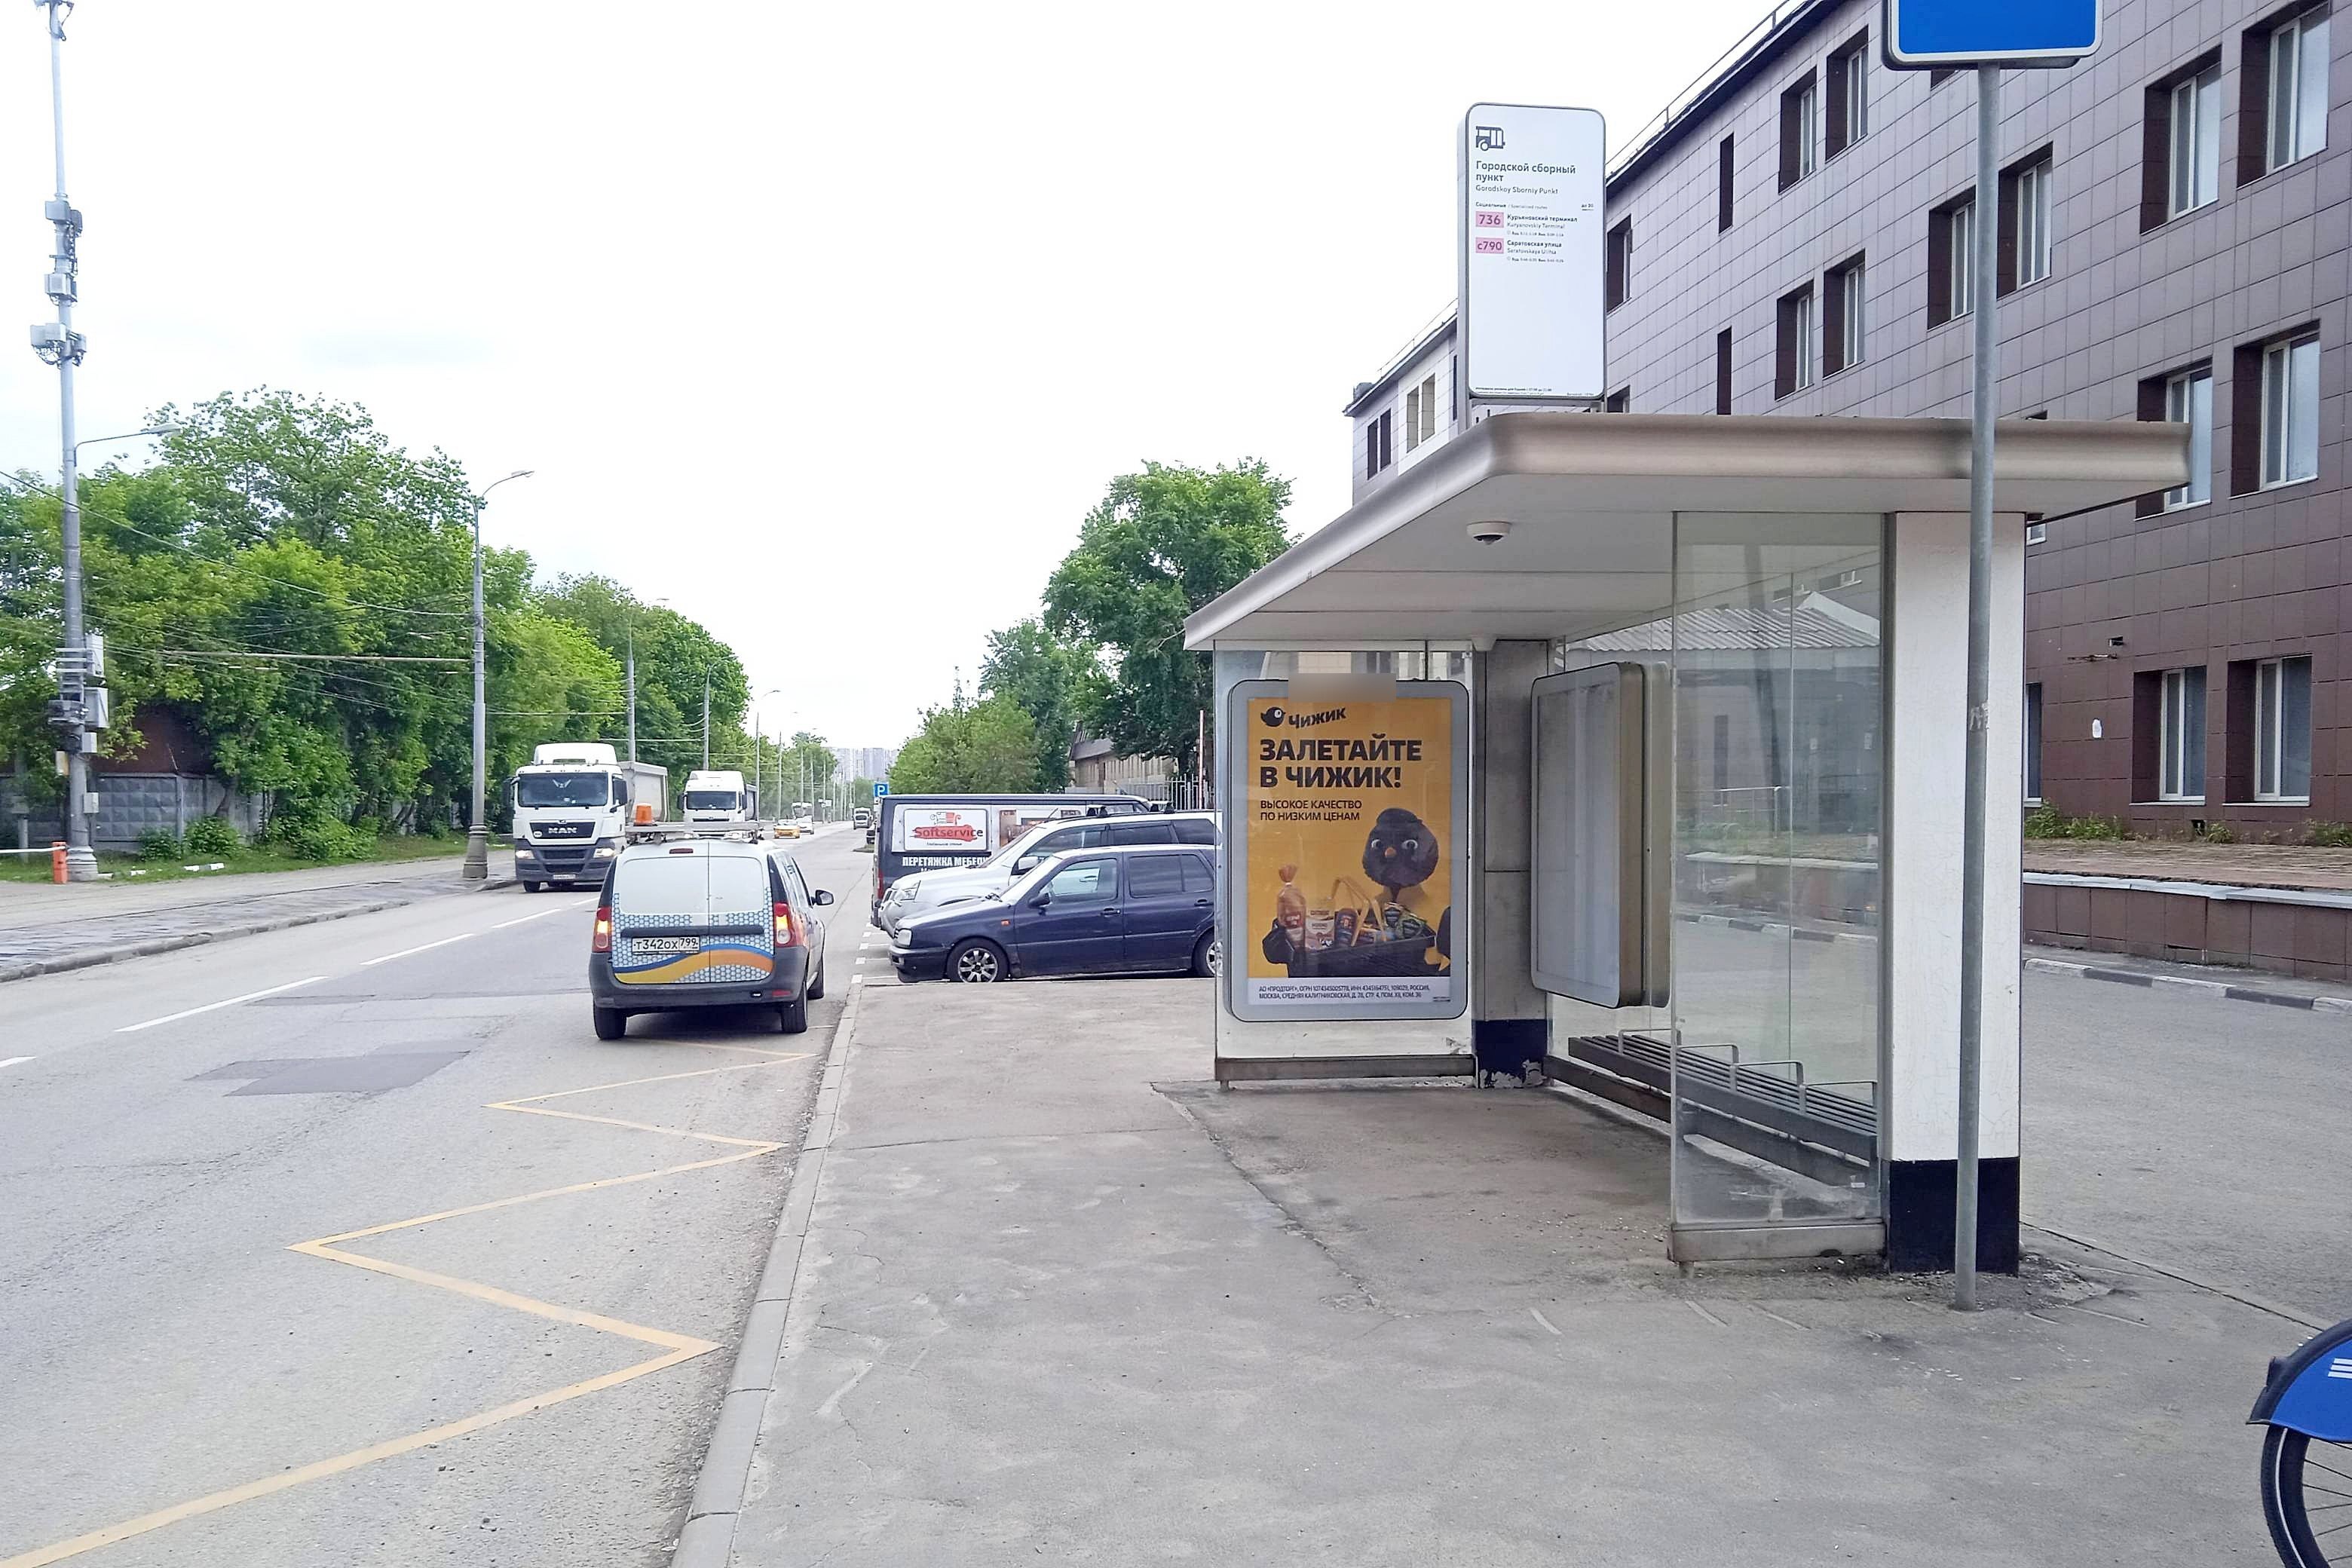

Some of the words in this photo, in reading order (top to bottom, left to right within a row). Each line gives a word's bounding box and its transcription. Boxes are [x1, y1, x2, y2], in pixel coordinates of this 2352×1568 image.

[1476, 161, 1530, 172] Городской
[1532, 163, 1576, 174] сборный
[1476, 174, 1504, 182] пункт
[1475, 185, 1511, 194] Gorodskoy
[1512, 186, 1538, 194] Sborniy
[1478, 214, 1501, 225] 736
[1260, 733, 1423, 761] ЗАЛЕТАЙТЕ
[1260, 766, 1278, 788] В
[1285, 766, 1401, 789] ЧИЖИК!
[1260, 800, 1309, 809] ВЫСОКОЕ
[1311, 800, 1362, 809] КАЧЕСТВО
[1260, 812, 1276, 821] ПО
[1278, 812, 1321, 821] НИЗКИМ
[1324, 812, 1360, 822] ЦЕНАМ
[915, 828, 984, 838] Softservice
[902, 856, 953, 867] ПЕРЕТЯЖКА
